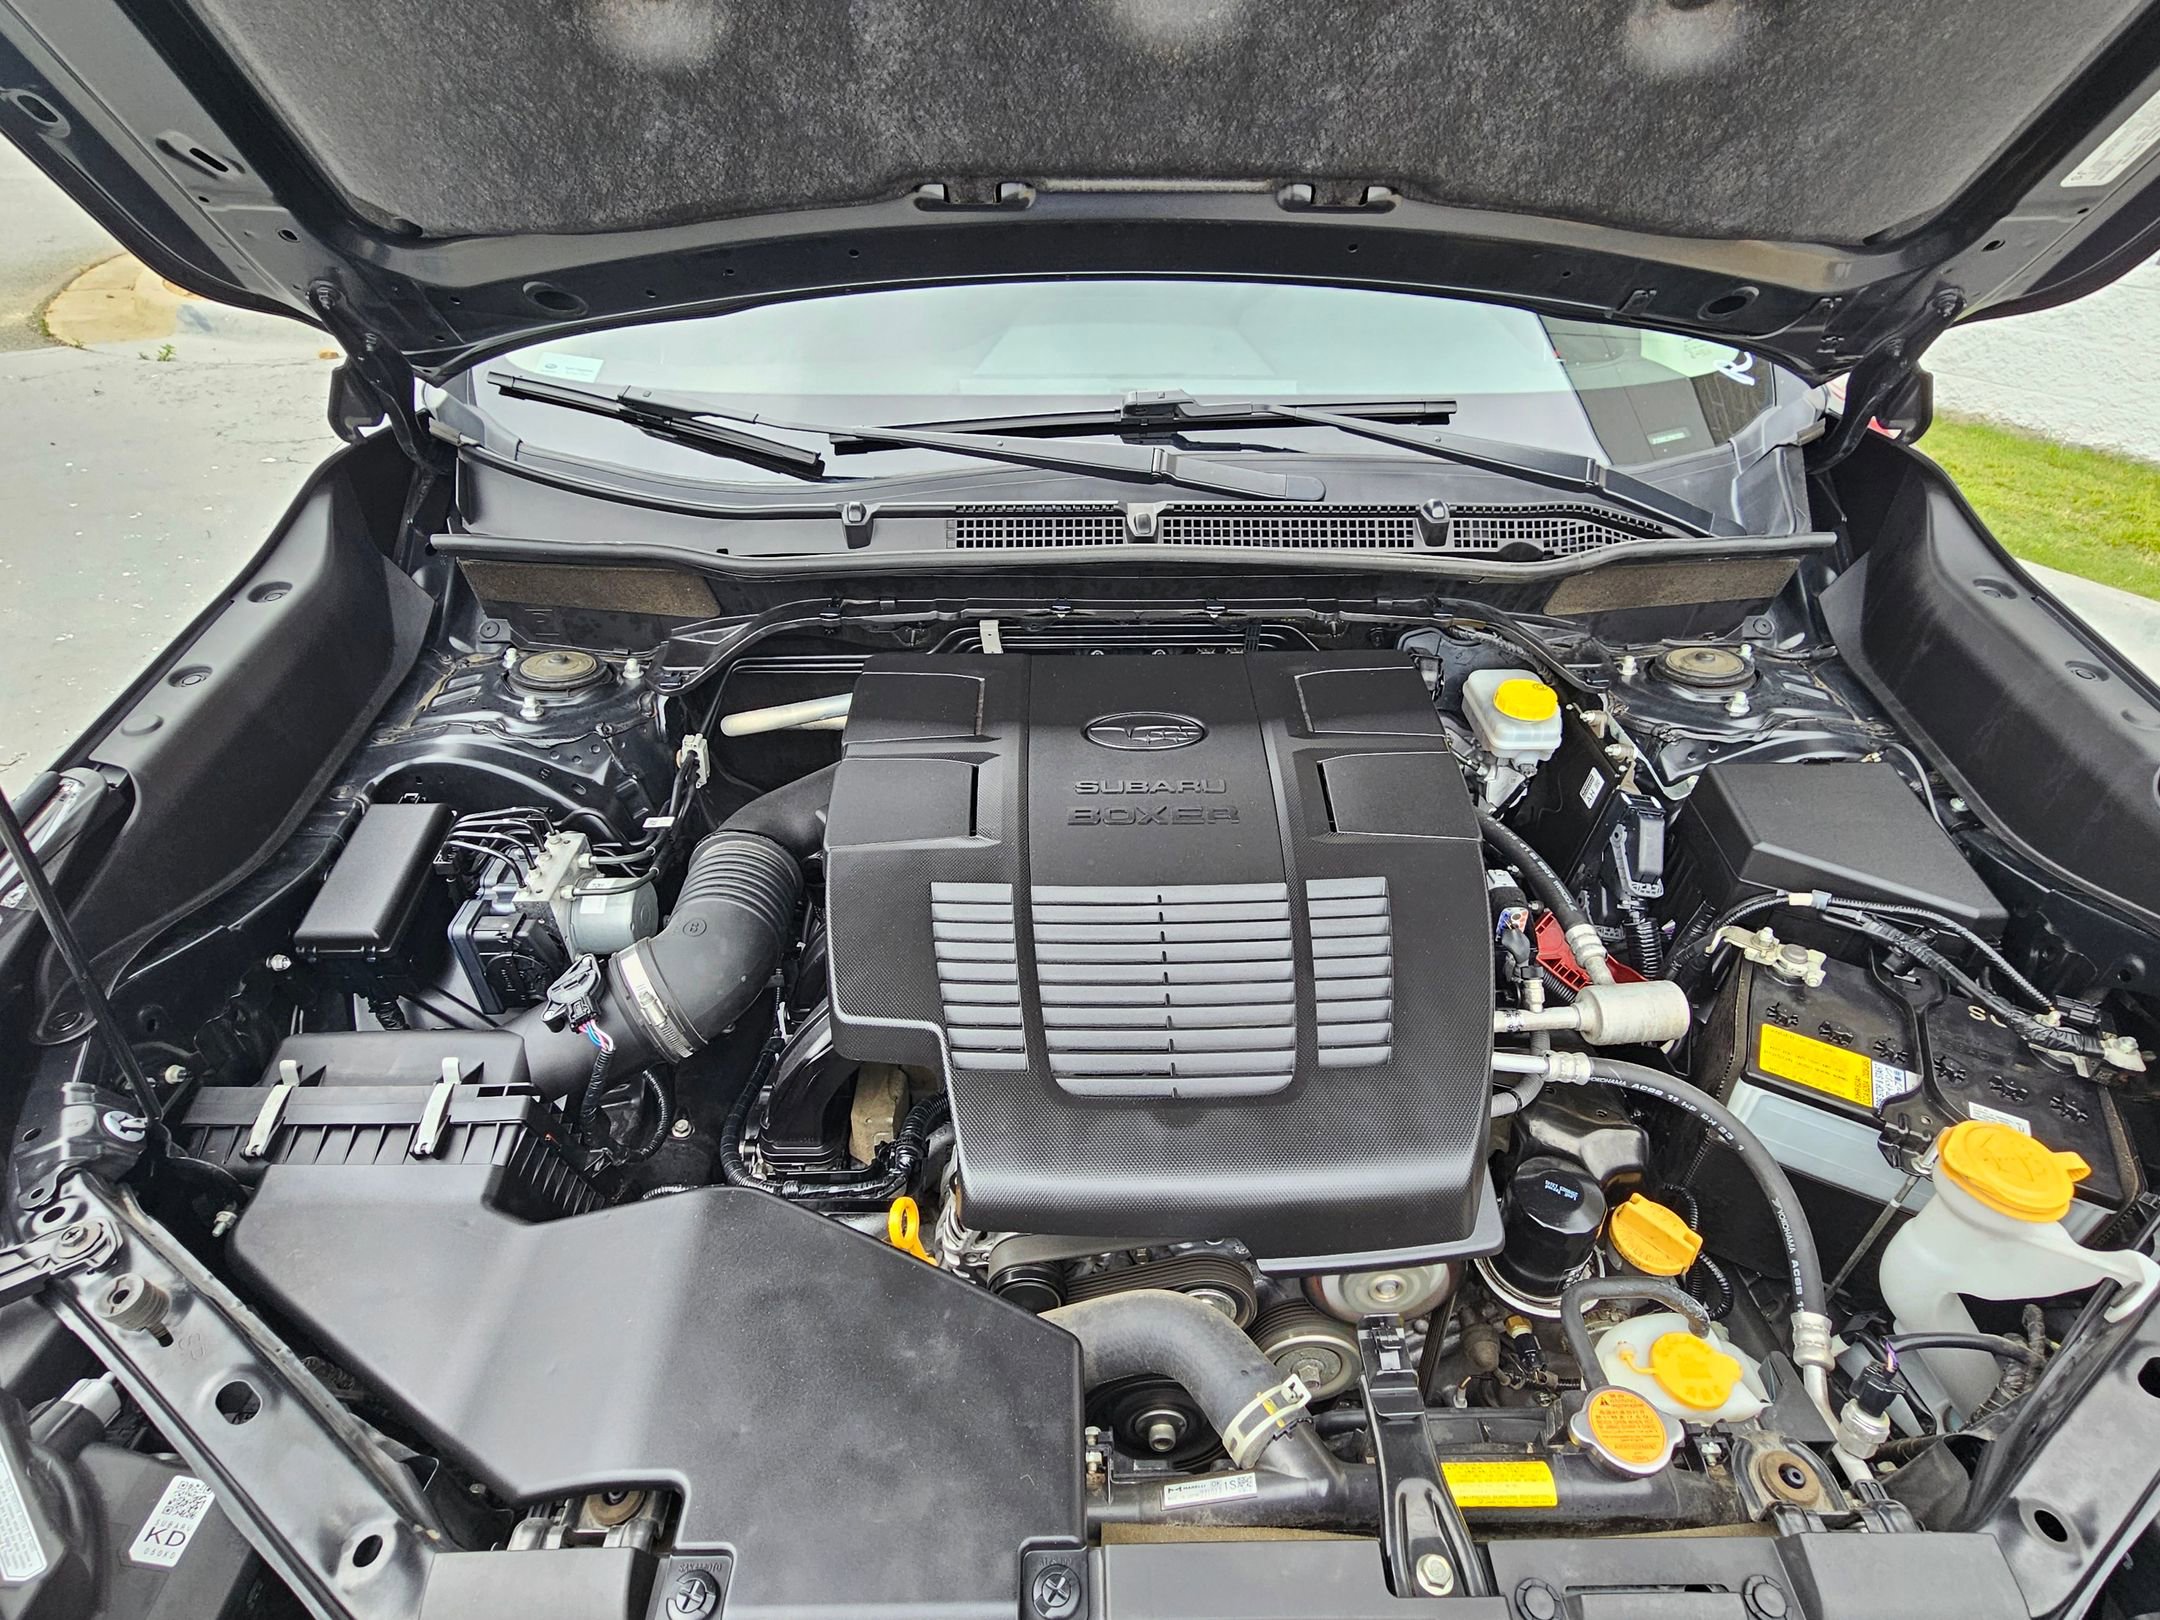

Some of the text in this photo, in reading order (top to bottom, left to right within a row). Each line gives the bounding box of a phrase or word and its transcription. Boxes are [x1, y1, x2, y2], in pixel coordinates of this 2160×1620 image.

[1074, 779, 1227, 794] SUBARU
[1067, 806, 1240, 826] BOXER
[1777, 1207, 1797, 1254] YOKOHAMA
[155, 1519, 194, 1532] SUBARU
[144, 1526, 186, 1546] KD
